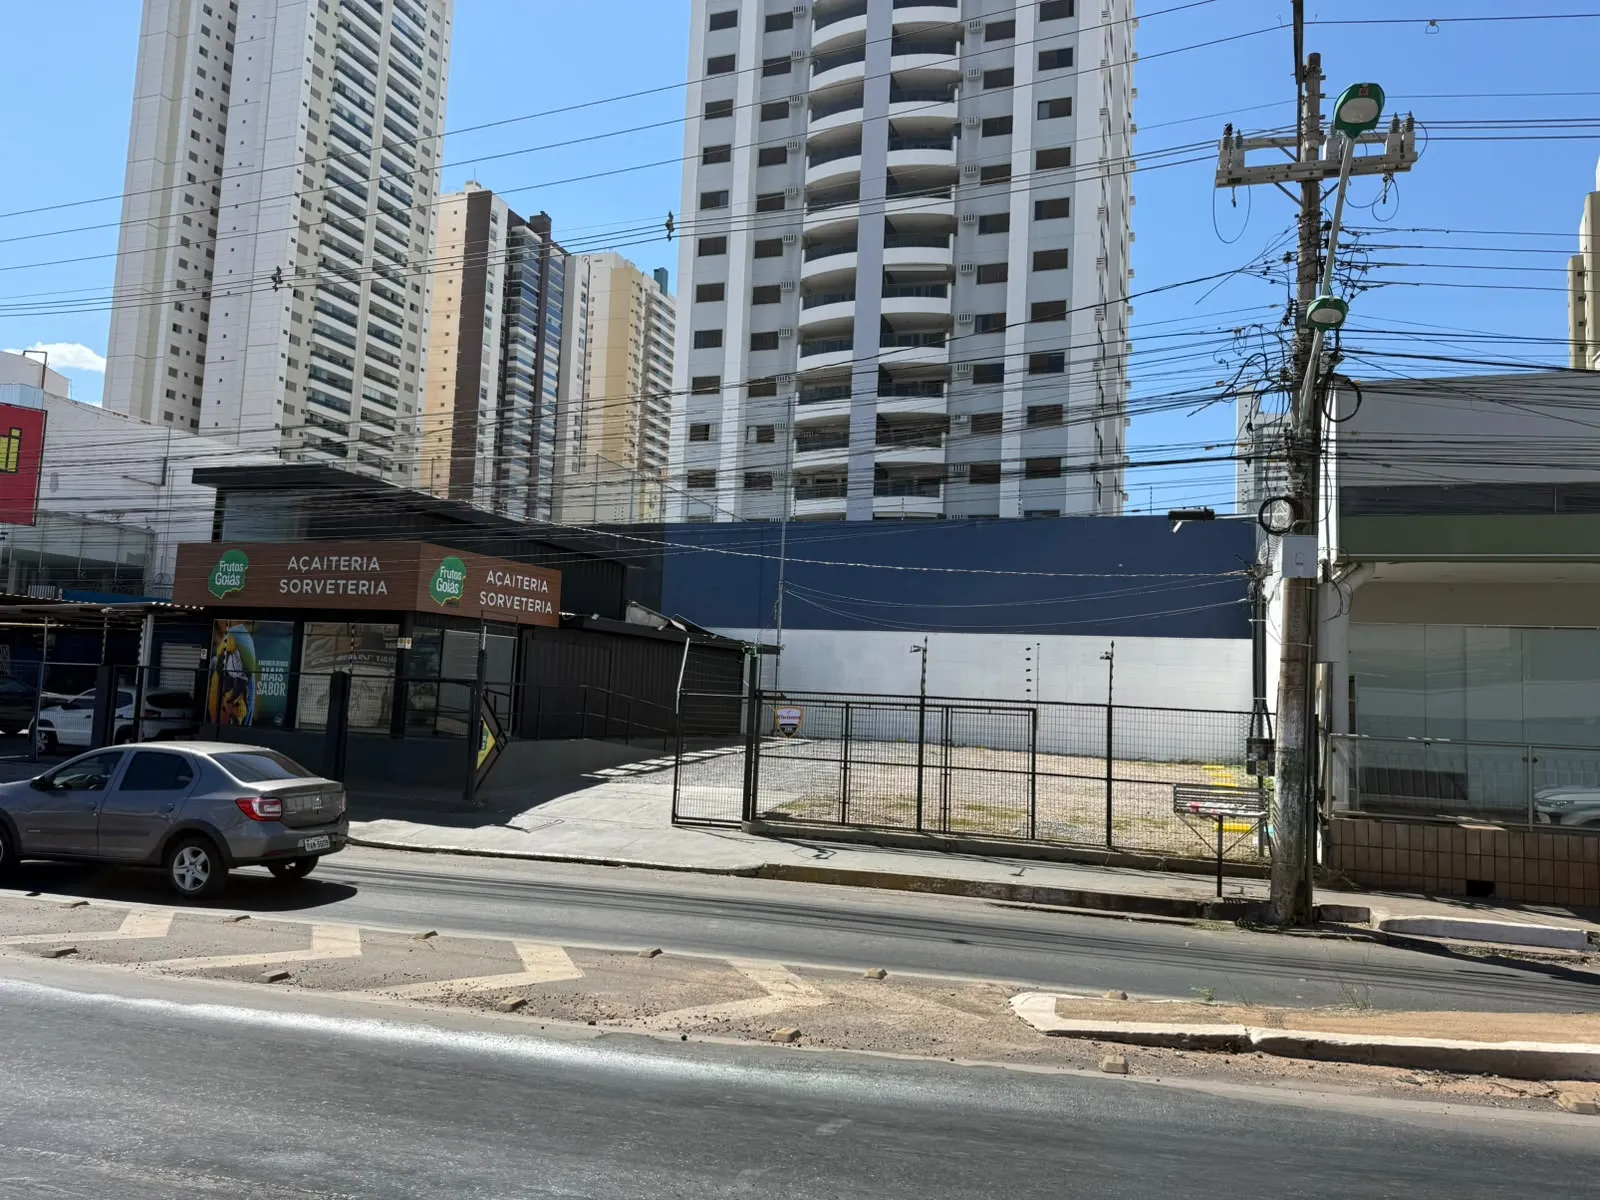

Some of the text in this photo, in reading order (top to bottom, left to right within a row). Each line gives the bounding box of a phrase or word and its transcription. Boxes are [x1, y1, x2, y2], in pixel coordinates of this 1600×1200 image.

[219, 560, 244, 572] Frutos
[287, 556, 380, 573] AÇAITERIA
[215, 572, 240, 586] Goiás
[440, 565, 462, 580] Frutos
[279, 579, 388, 595] SORVETERIA
[436, 577, 459, 594] Goiás
[486, 570, 549, 593] AÇAITERIA
[479, 591, 553, 614] SORVETERIA
[261, 667, 284, 682] MAIS
[256, 681, 286, 696] SABOR
